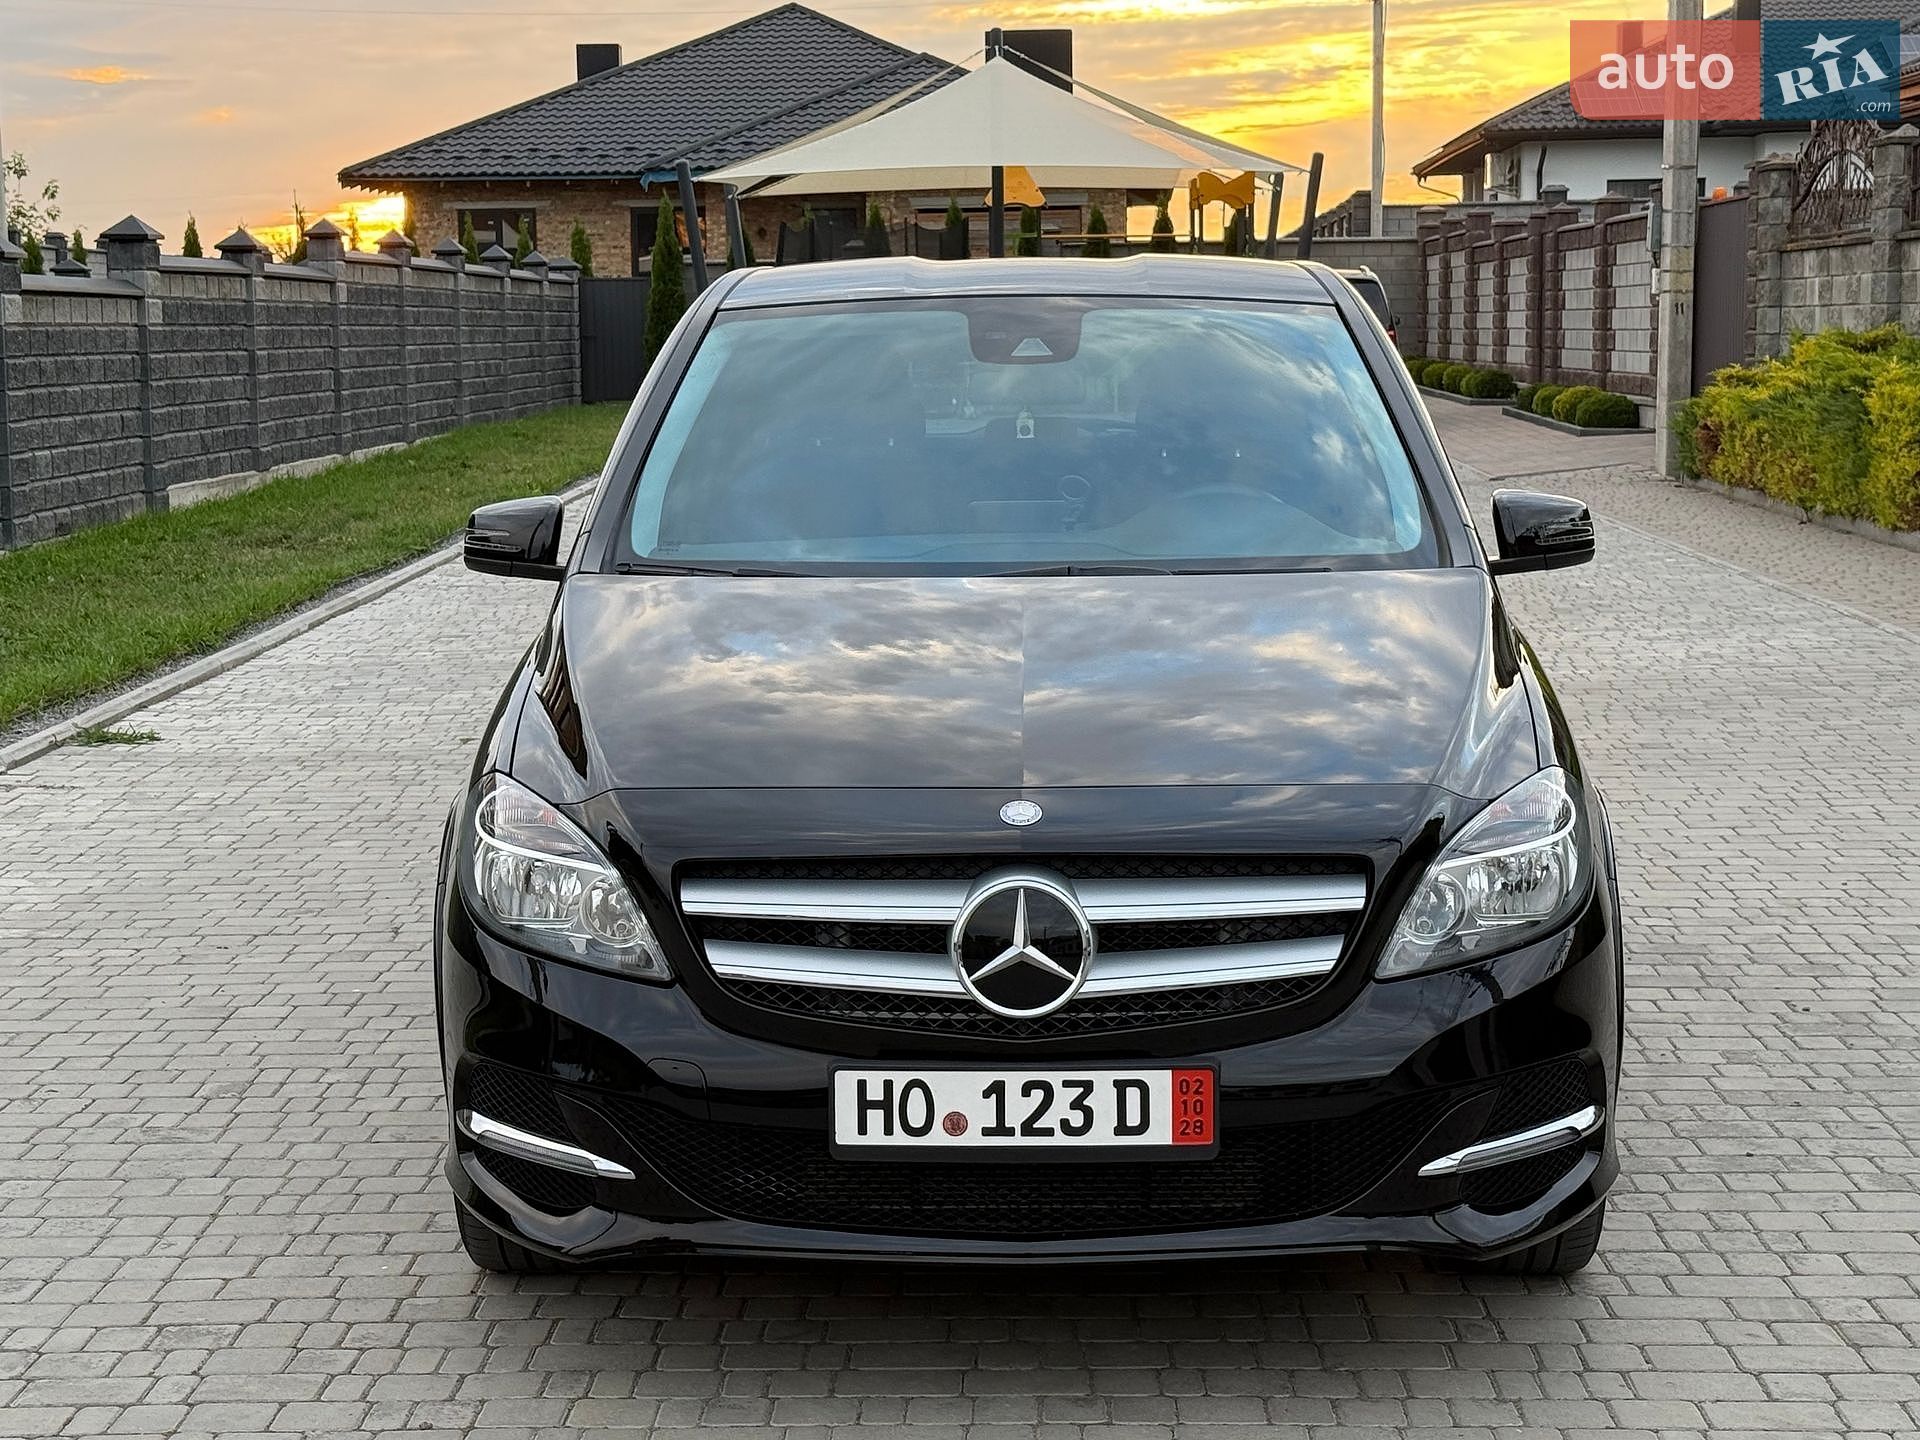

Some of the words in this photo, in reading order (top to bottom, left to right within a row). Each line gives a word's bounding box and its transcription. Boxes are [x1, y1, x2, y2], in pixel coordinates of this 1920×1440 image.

[1179, 1078, 1204, 1095] 02
[857, 1079, 935, 1137] HO
[981, 1080, 1094, 1137] 123
[1113, 1079, 1151, 1137] D
[1181, 1098, 1204, 1116] 10
[1179, 1119, 1204, 1136] 28
